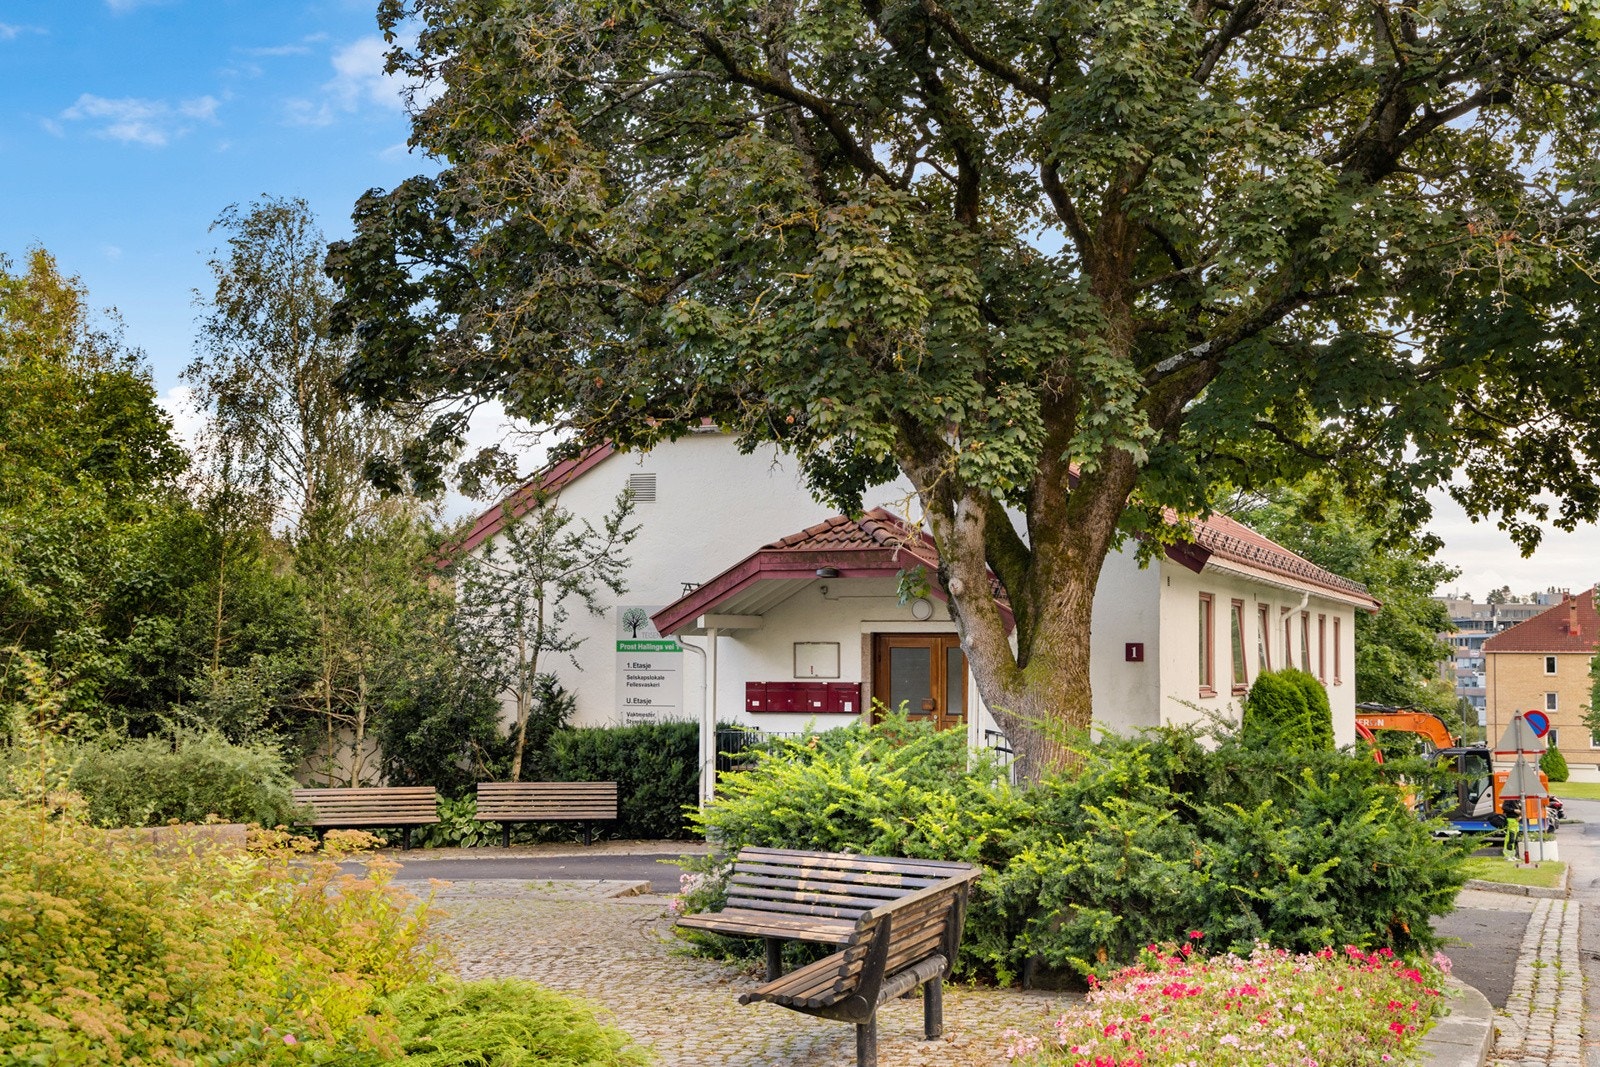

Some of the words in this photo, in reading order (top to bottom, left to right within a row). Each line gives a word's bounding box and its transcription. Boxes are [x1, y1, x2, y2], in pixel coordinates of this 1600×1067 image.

[638, 643, 663, 651] Hallings
[1131, 646, 1137, 658] 1
[633, 662, 651, 671] Etasje
[633, 697, 652, 706] Etasje
